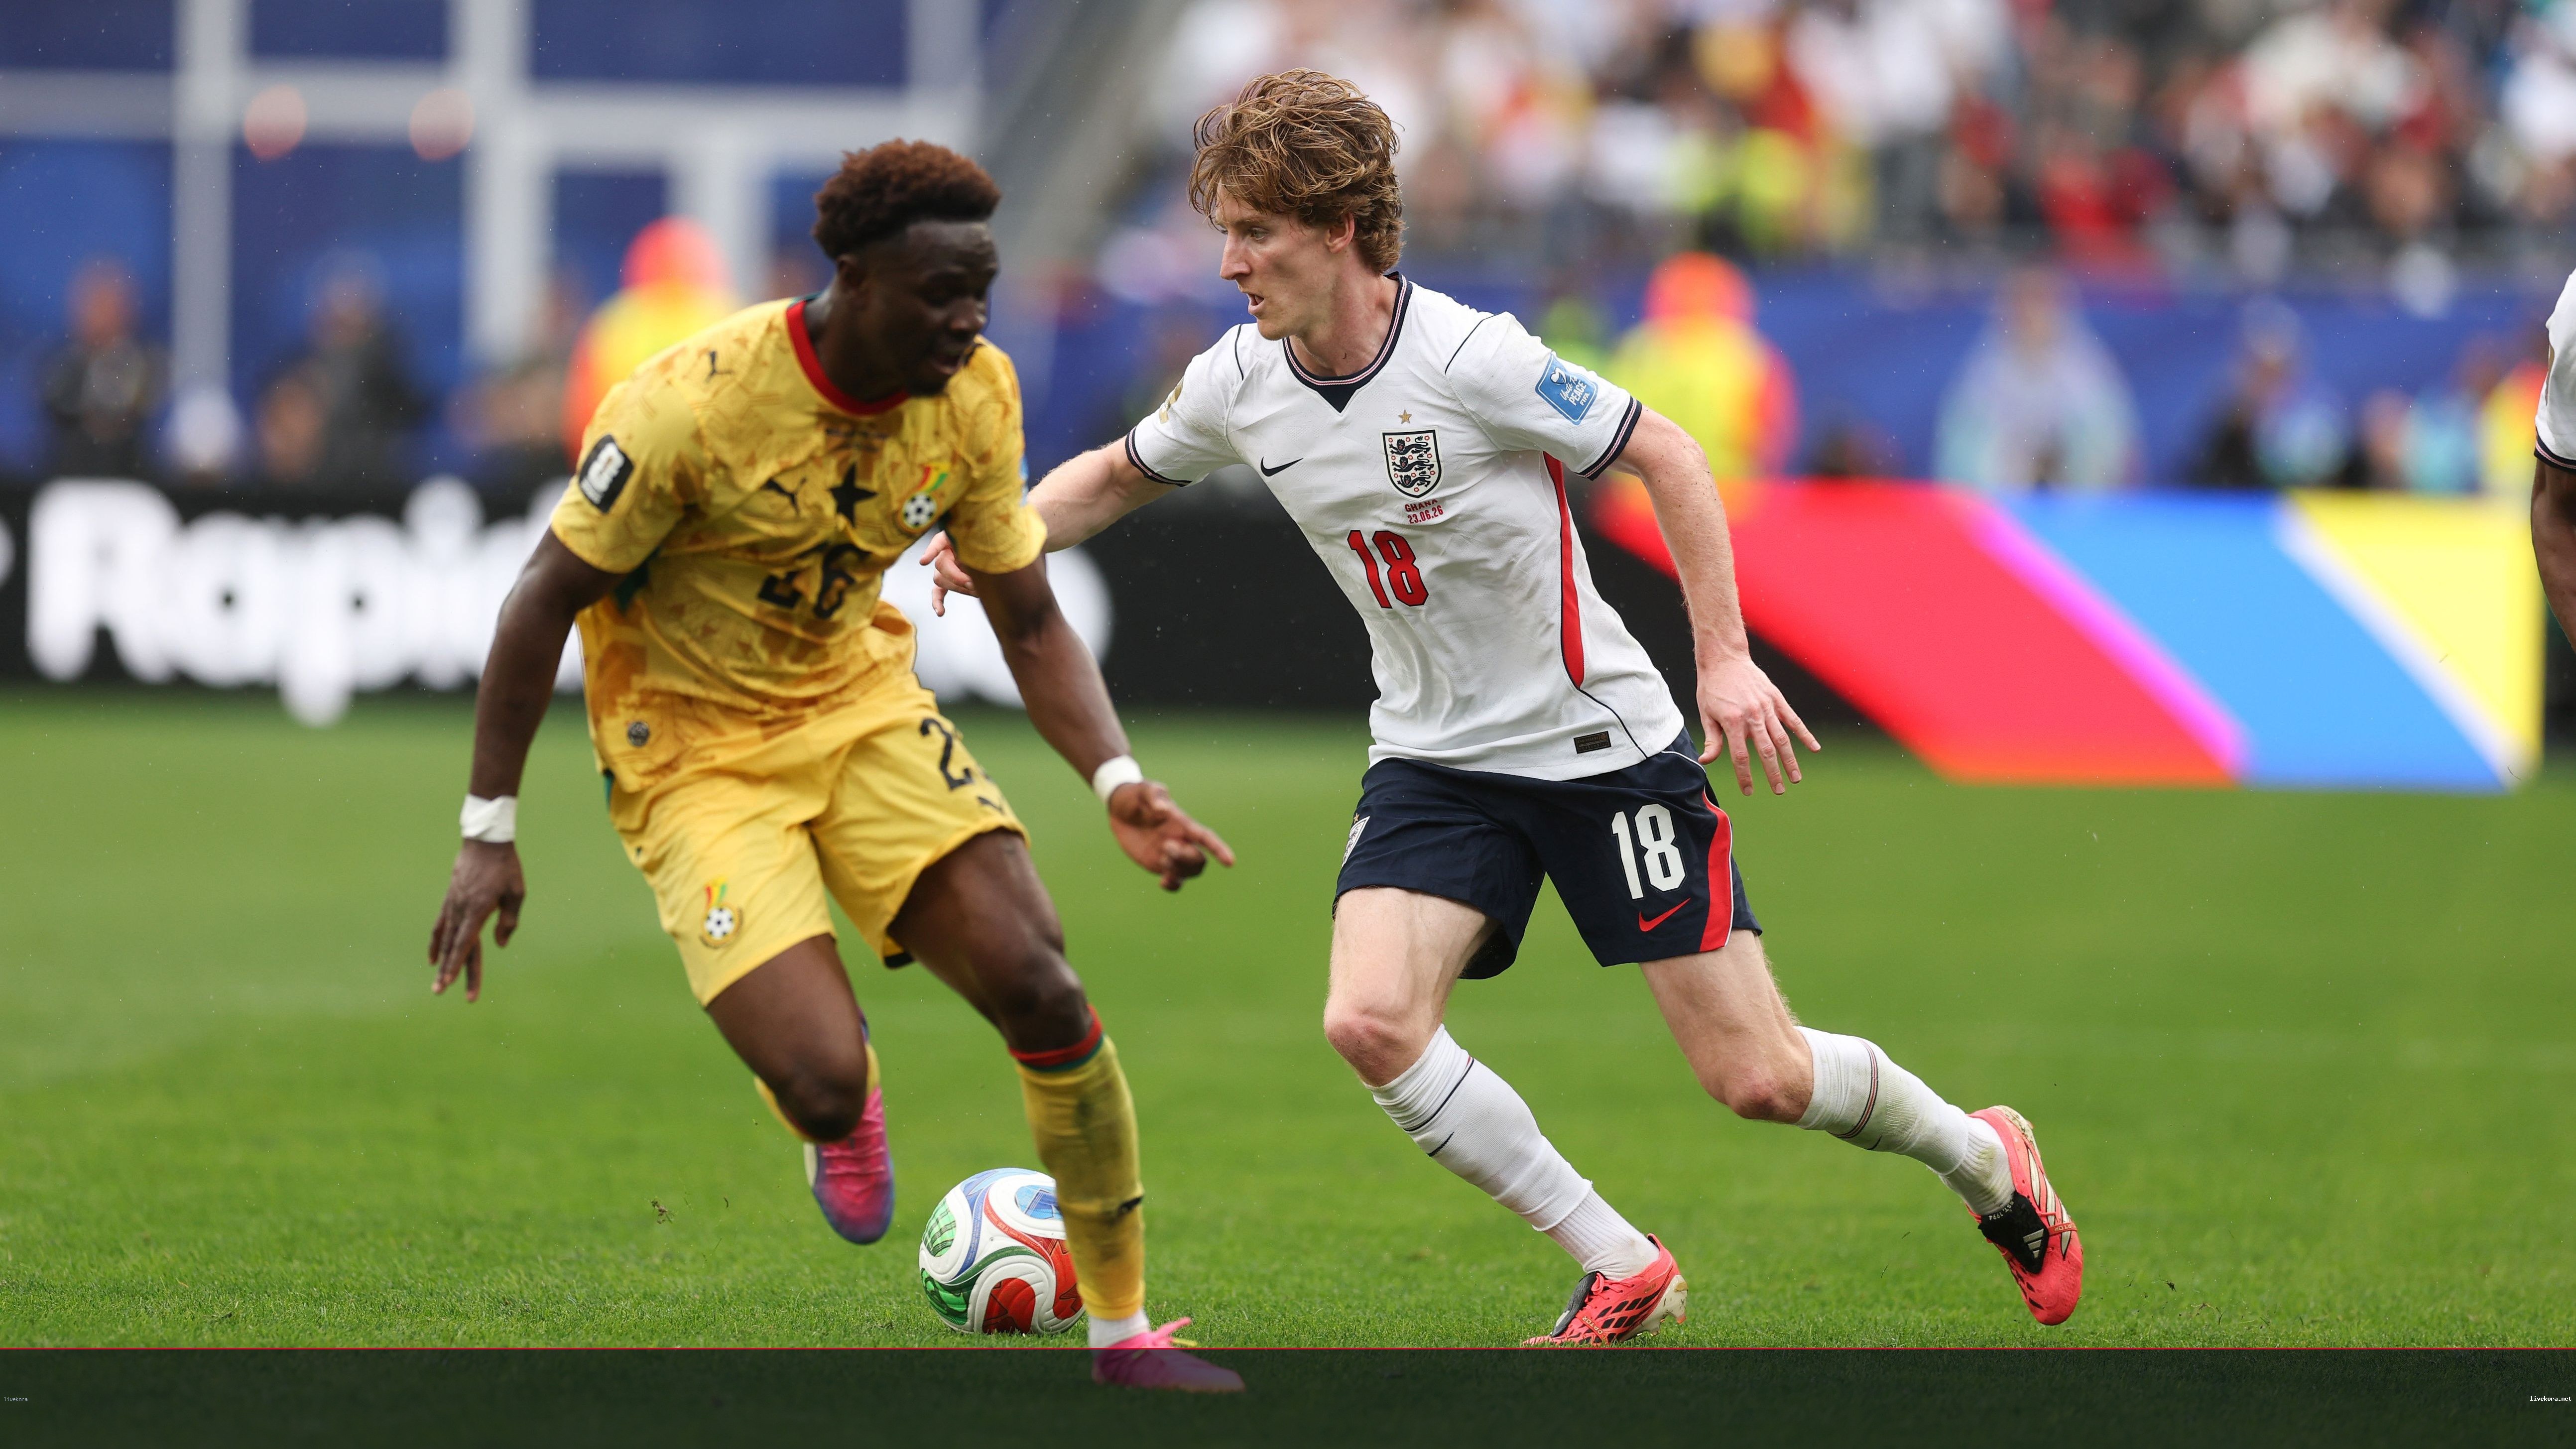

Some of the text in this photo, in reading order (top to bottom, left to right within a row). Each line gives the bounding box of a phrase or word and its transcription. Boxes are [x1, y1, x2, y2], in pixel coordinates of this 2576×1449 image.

[1569, 380, 1587, 406] PEACE
[1580, 392, 1590, 406] FIFA
[1404, 498, 1439, 513] GHANA
[1407, 504, 1444, 524] 23.06.26
[1347, 530, 1429, 609] 18
[920, 718, 990, 791] 2
[1611, 803, 1687, 899] 18
